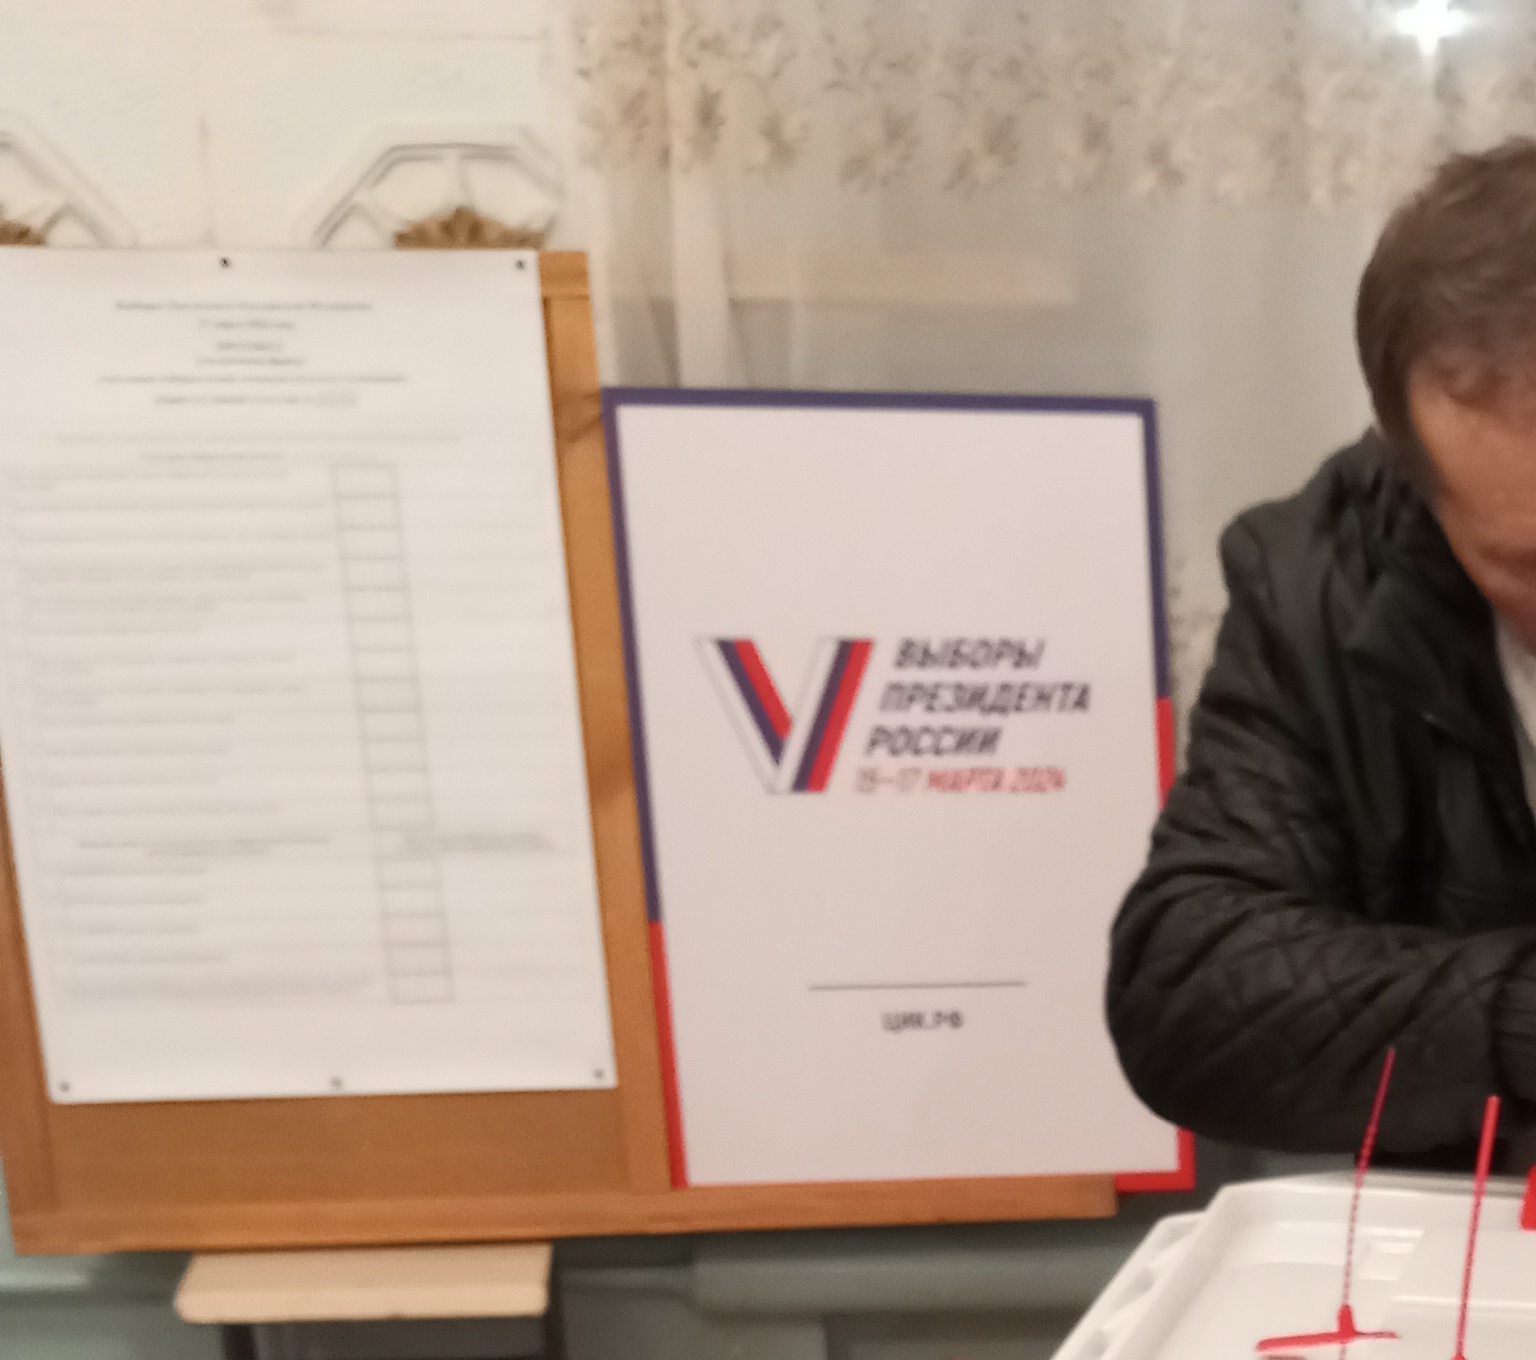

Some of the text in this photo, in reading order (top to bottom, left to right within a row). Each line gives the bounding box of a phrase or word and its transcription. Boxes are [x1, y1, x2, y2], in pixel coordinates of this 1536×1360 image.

[895, 637, 1047, 671] ВЫБОРЫ
[879, 681, 1091, 717] ПРЕЗИДЕНТА
[864, 725, 1004, 757] РОССИИ
